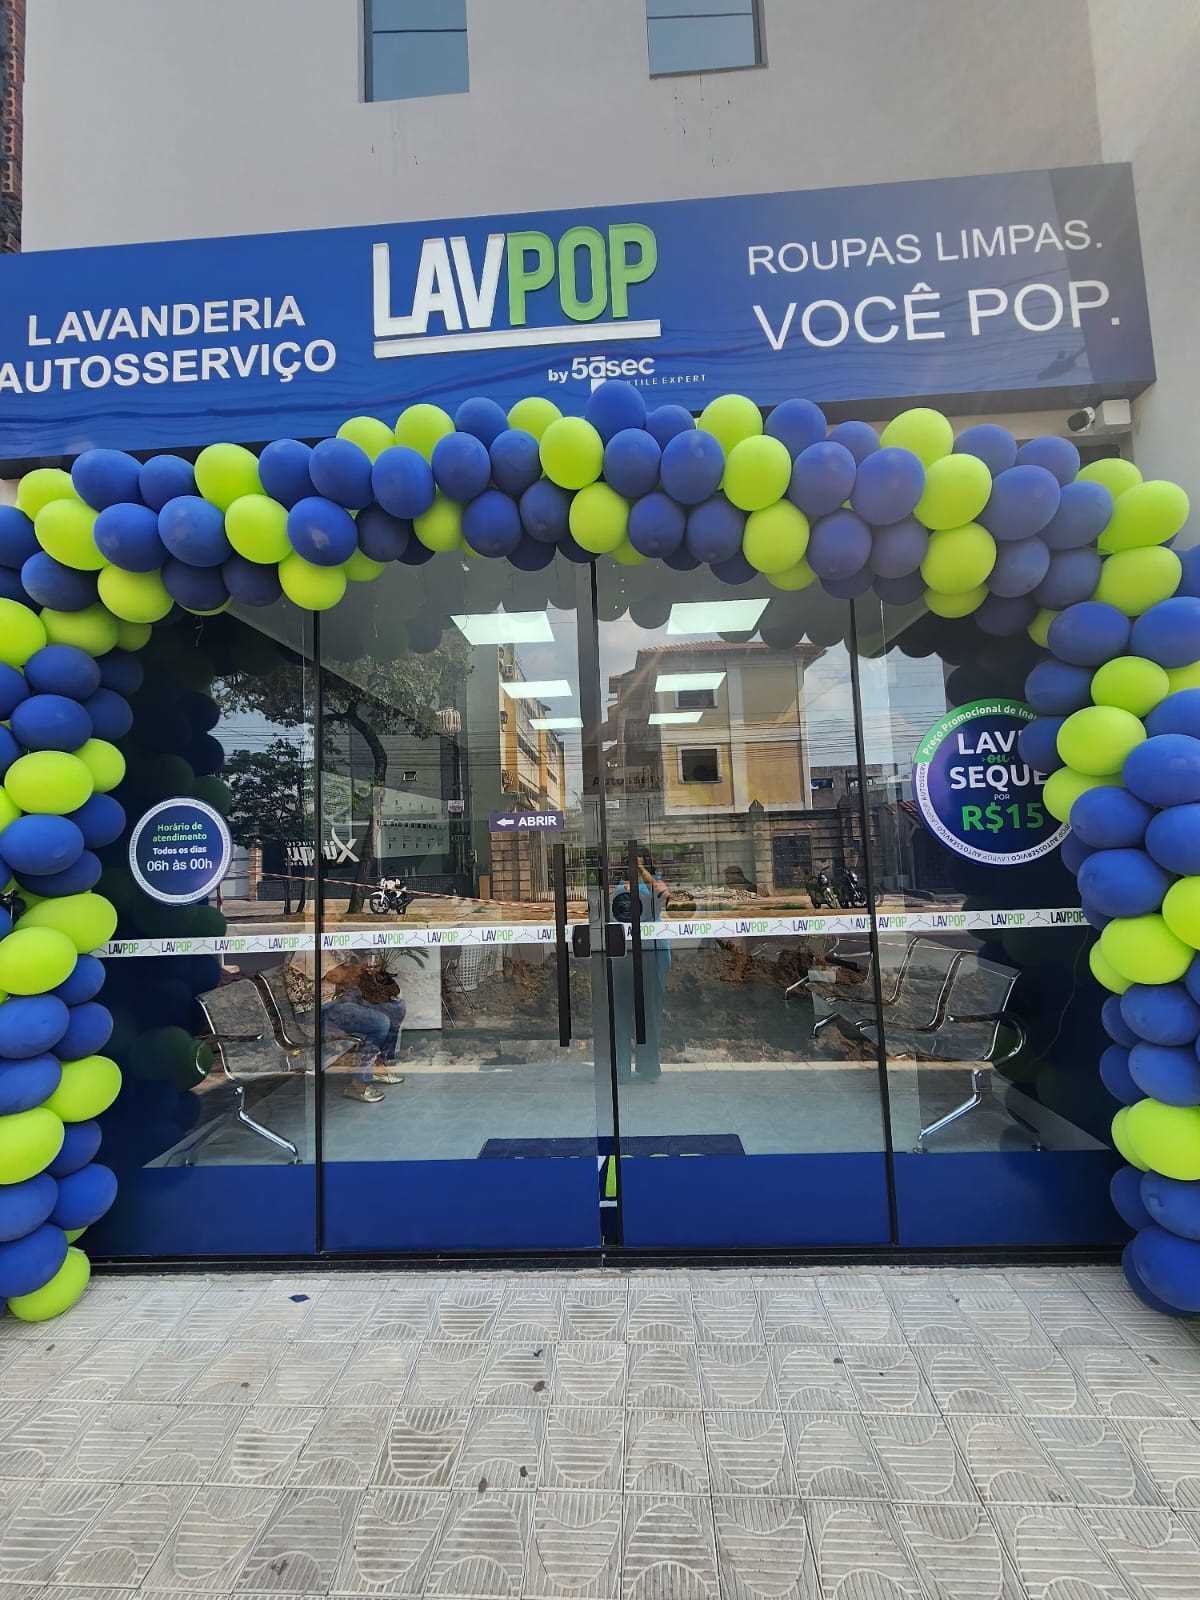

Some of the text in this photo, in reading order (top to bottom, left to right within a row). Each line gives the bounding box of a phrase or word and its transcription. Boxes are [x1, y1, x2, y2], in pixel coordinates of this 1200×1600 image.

[748, 219, 1103, 276] ROUPAS LIMPAS.
[372, 223, 659, 337] LAVPOP
[28, 295, 306, 346] LAVANDERIA
[753, 279, 1121, 352] VOCÊ POP.
[0, 339, 337, 394] AUTOSSERVIÇO
[548, 369, 569, 384] by
[662, 374, 706, 385] EXPERT
[922, 731, 944, 756] Preço
[942, 704, 1002, 732] Promocional
[1003, 705, 1016, 714] de
[957, 729, 1023, 755] LAV
[994, 793, 1010, 801] POR
[157, 821, 203, 832] Horário de
[518, 815, 558, 827] ABRIR
[152, 832, 208, 843] atendimento
[152, 846, 177, 855] Todos
[190, 845, 207, 853] dias
[172, 859, 187, 870] às
[190, 858, 213, 870] 00h
[108, 942, 140, 955] LAVPOP
[161, 941, 192, 954] LAVPOP
[214, 940, 246, 952] LAVPOP
[268, 937, 300, 949] LAVPOP
[323, 935, 351, 947] AVPOP
[373, 933, 404, 945] LAVPOP
[427, 931, 460, 943] LAVPOP
[482, 929, 513, 942] LAVPOP
[679, 923, 712, 935] LAVPOP
[735, 921, 768, 933] LAVPOP
[792, 919, 826, 932] LAVPOP
[878, 916, 907, 928] AVPOP
[932, 914, 966, 927] LAVPOP
[990, 912, 1025, 925] LAVPOP
